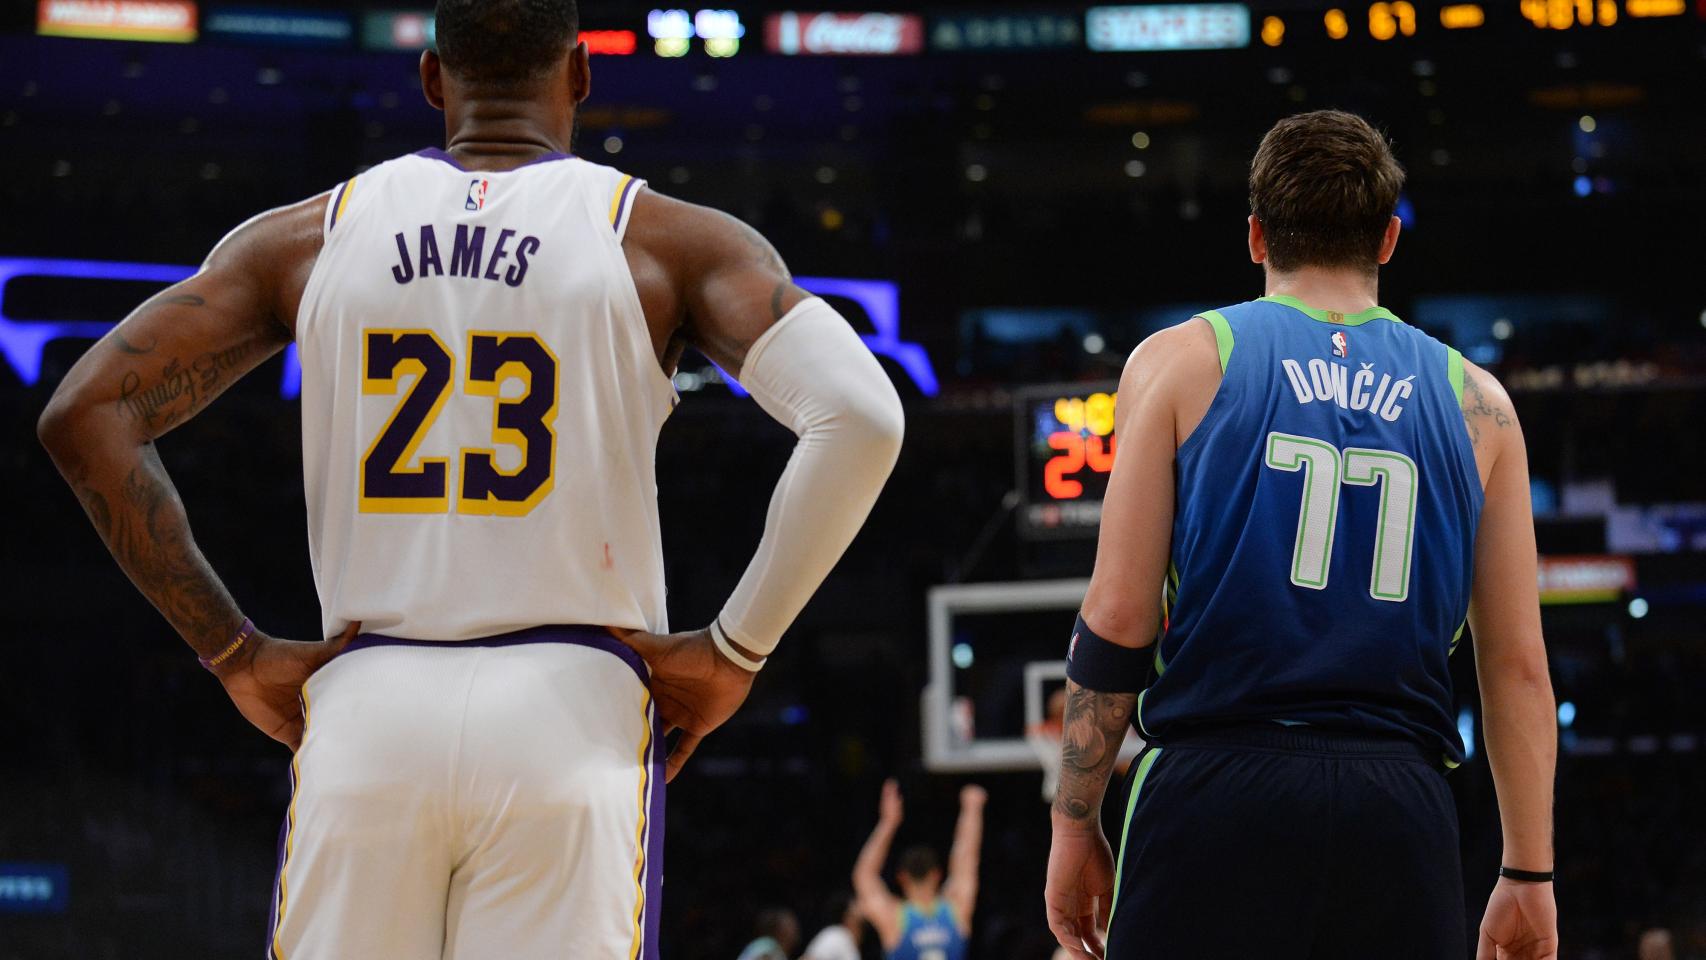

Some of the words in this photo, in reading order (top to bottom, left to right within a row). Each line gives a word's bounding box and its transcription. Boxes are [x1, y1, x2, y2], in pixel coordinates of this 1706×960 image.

[391, 223, 541, 288] JAMES
[358, 327, 561, 517] 23
[1281, 358, 1417, 422] DONČIĆ
[1265, 431, 1419, 602] 77
[210, 638, 244, 666] PROMISE
